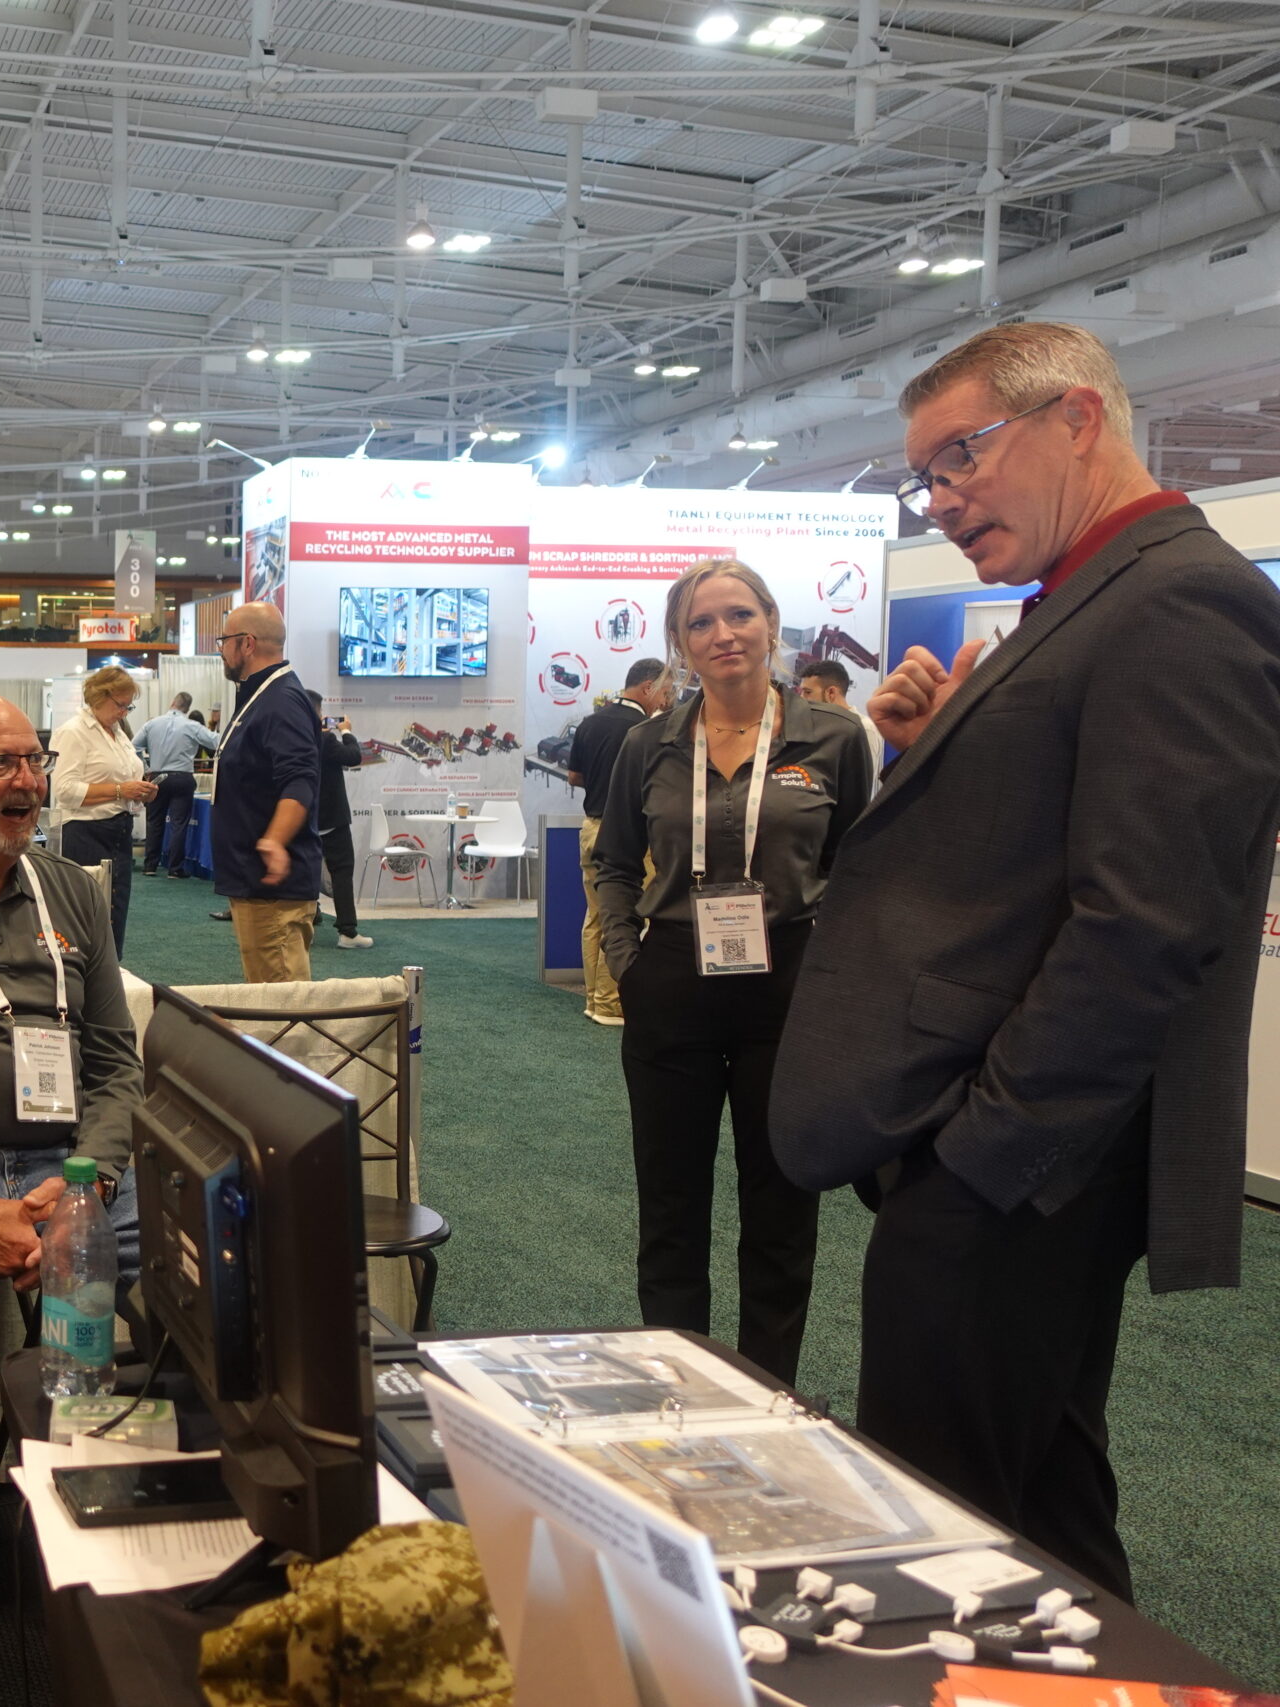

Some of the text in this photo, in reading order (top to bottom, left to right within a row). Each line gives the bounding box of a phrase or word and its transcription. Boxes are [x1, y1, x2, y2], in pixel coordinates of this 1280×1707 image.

[716, 511, 791, 521] EQUIPMENT
[798, 513, 885, 523] TECHNOLOGY
[667, 524, 885, 537] Metal Recycling Plant Since 2006
[326, 530, 494, 544] THE MOST ADVANCED METAL
[305, 543, 515, 557] RECYCLING TECHNOLOGY SUPPLIER
[543, 551, 578, 562] SCRAP
[580, 552, 638, 562] SHREDDER
[640, 552, 647, 562] &
[649, 552, 696, 563] SORTING
[771, 772, 802, 780] Empire
